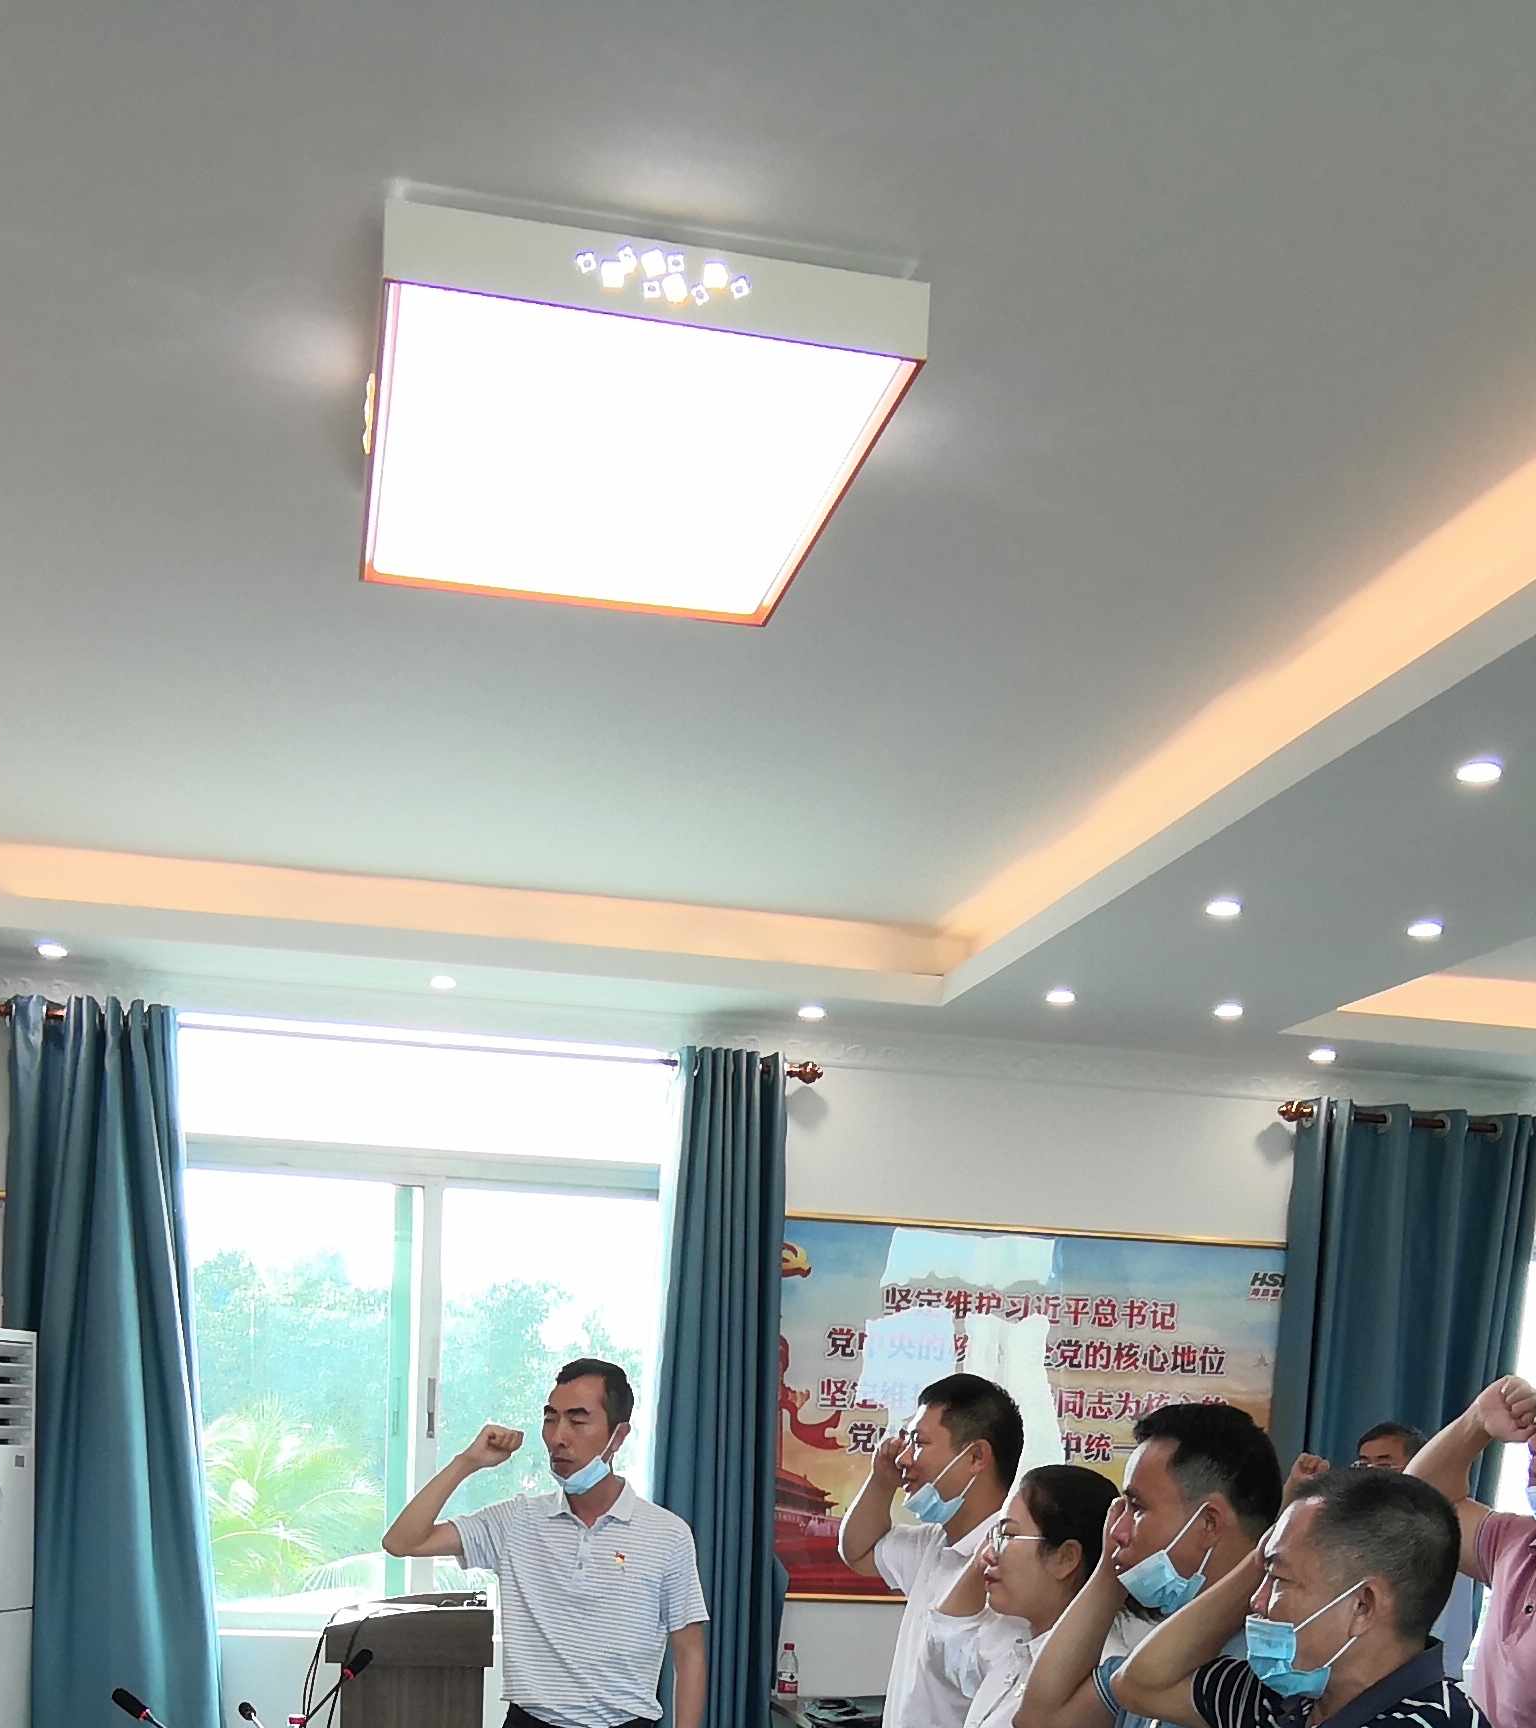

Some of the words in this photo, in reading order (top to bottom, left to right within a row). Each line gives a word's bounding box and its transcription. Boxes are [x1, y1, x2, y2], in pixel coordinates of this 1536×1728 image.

[885, 1285, 1177, 1331] 坚定维护习近平总书记
